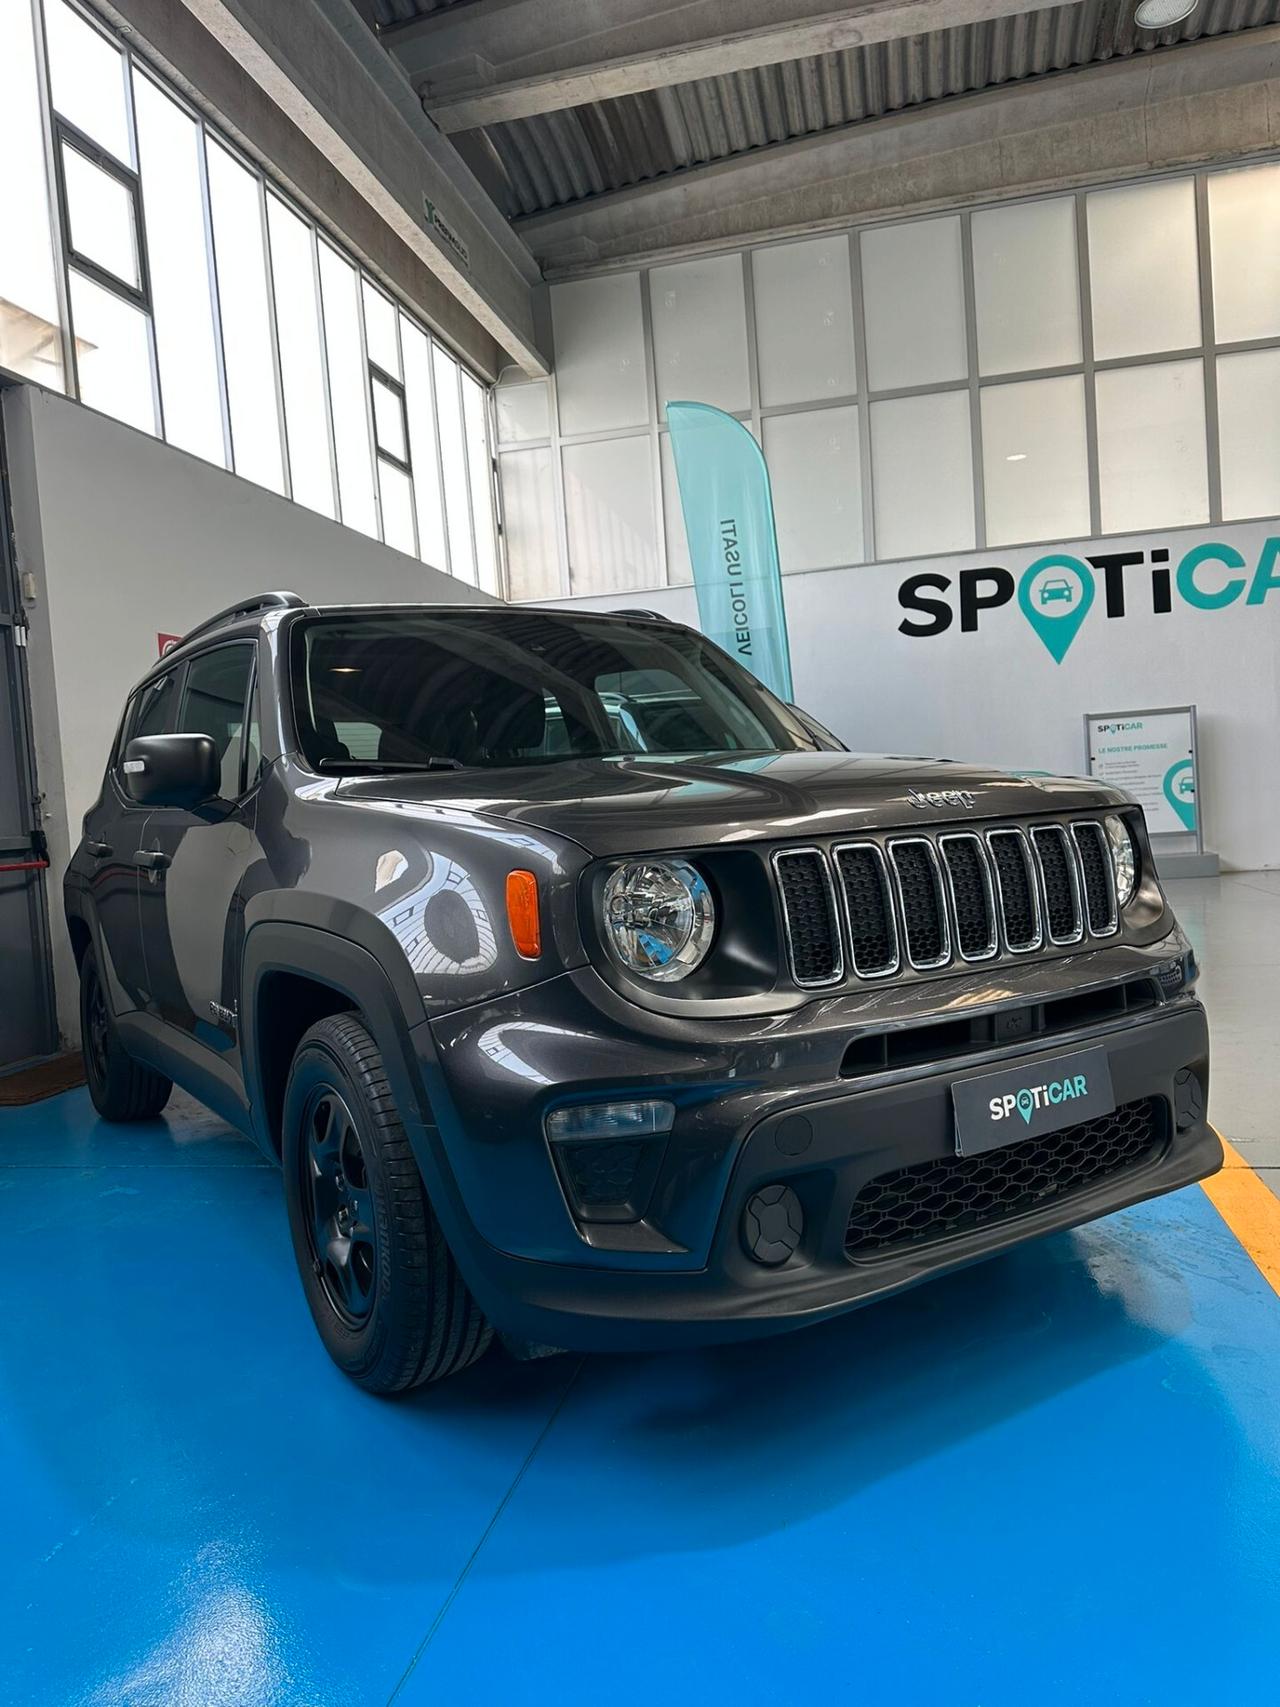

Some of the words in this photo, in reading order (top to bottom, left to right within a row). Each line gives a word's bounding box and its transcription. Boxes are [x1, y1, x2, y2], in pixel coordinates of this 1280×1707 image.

[1107, 745, 1133, 753] NOSTRE
[1133, 743, 1168, 751] PROMESSE
[906, 788, 976, 809] Jeep
